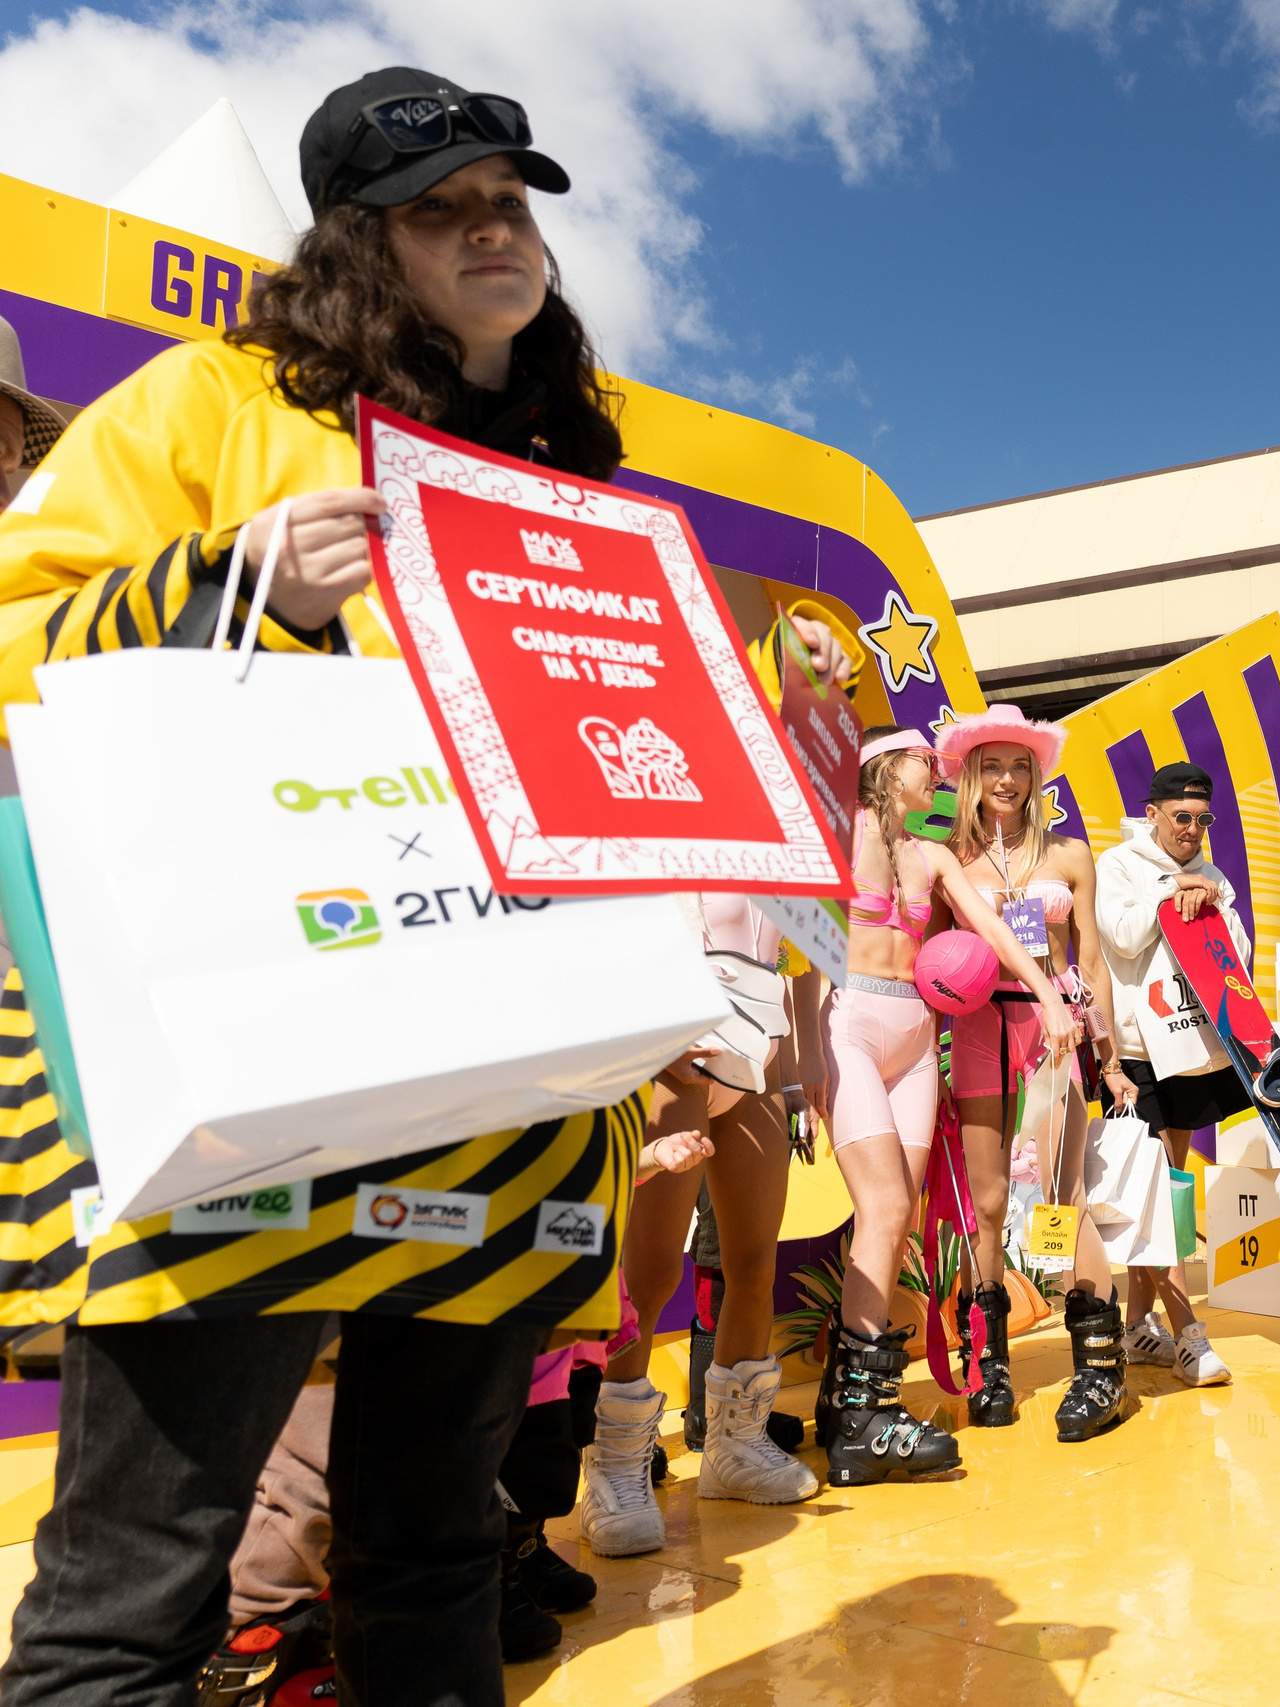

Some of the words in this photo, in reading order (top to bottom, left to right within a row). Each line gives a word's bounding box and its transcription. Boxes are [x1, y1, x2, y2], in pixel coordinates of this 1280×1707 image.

[150, 240, 271, 331] GR
[466, 569, 662, 625] СЕРТИФИКАТ
[512, 626, 665, 667] СНАРЯЖЕНИЕ
[541, 654, 580, 680] НА
[580, 659, 597, 683] 1
[598, 662, 656, 688] ДЕНЬ
[837, 703, 859, 754] 2024
[1016, 932, 1034, 941] 218
[1238, 1193, 1258, 1217] ПТ
[1044, 1241, 1063, 1250] 209
[1239, 1235, 1260, 1267] 19
